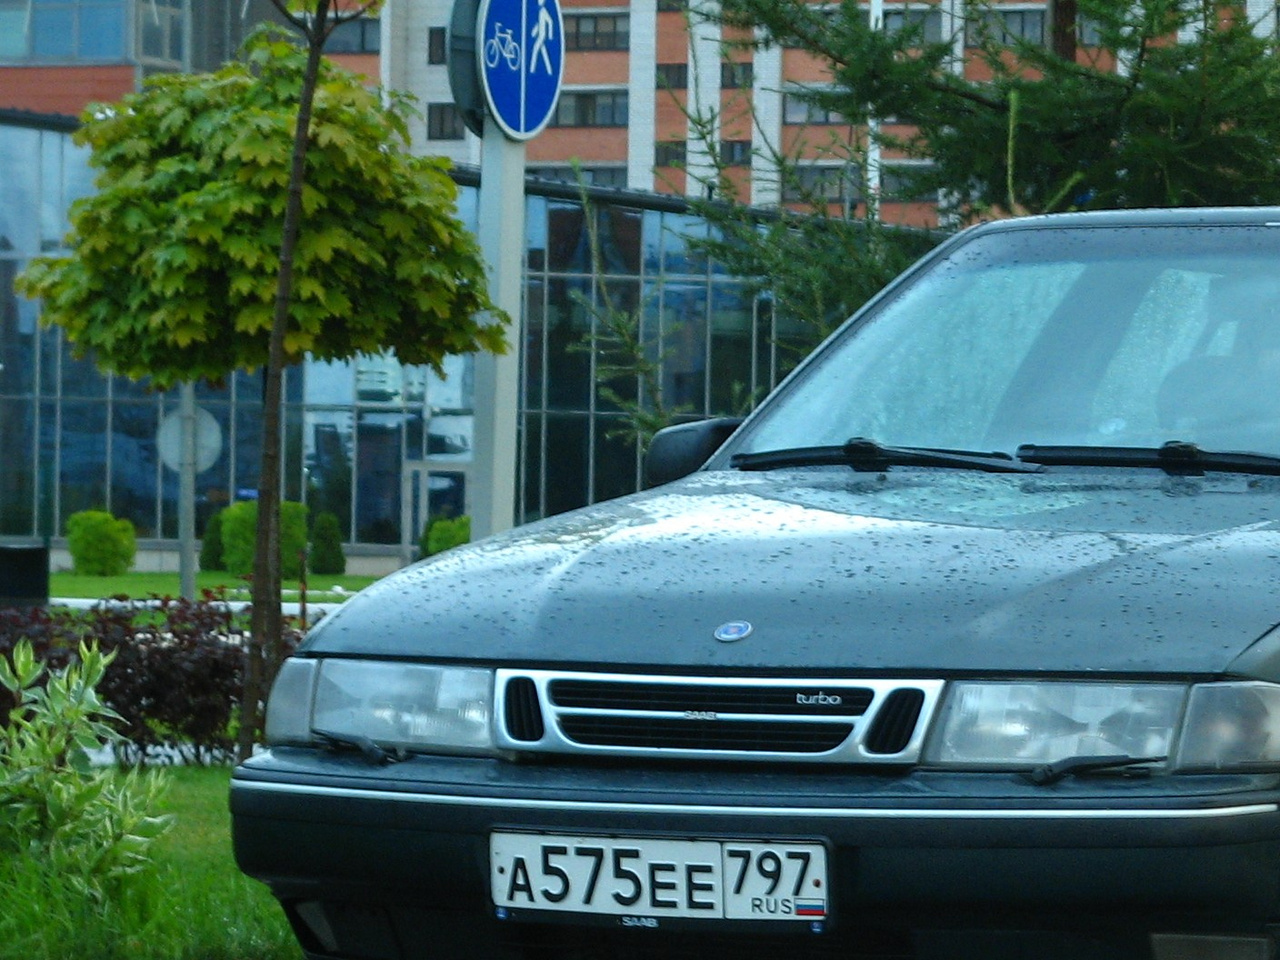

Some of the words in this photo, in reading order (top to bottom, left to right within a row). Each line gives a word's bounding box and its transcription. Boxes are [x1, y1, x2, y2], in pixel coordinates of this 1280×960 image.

[796, 691, 842, 705] turbo
[683, 710, 718, 721] SAAB
[506, 844, 715, 909] A575EE
[727, 849, 811, 896] 797
[751, 897, 793, 915] RUS
[621, 916, 660, 928] SAAB
